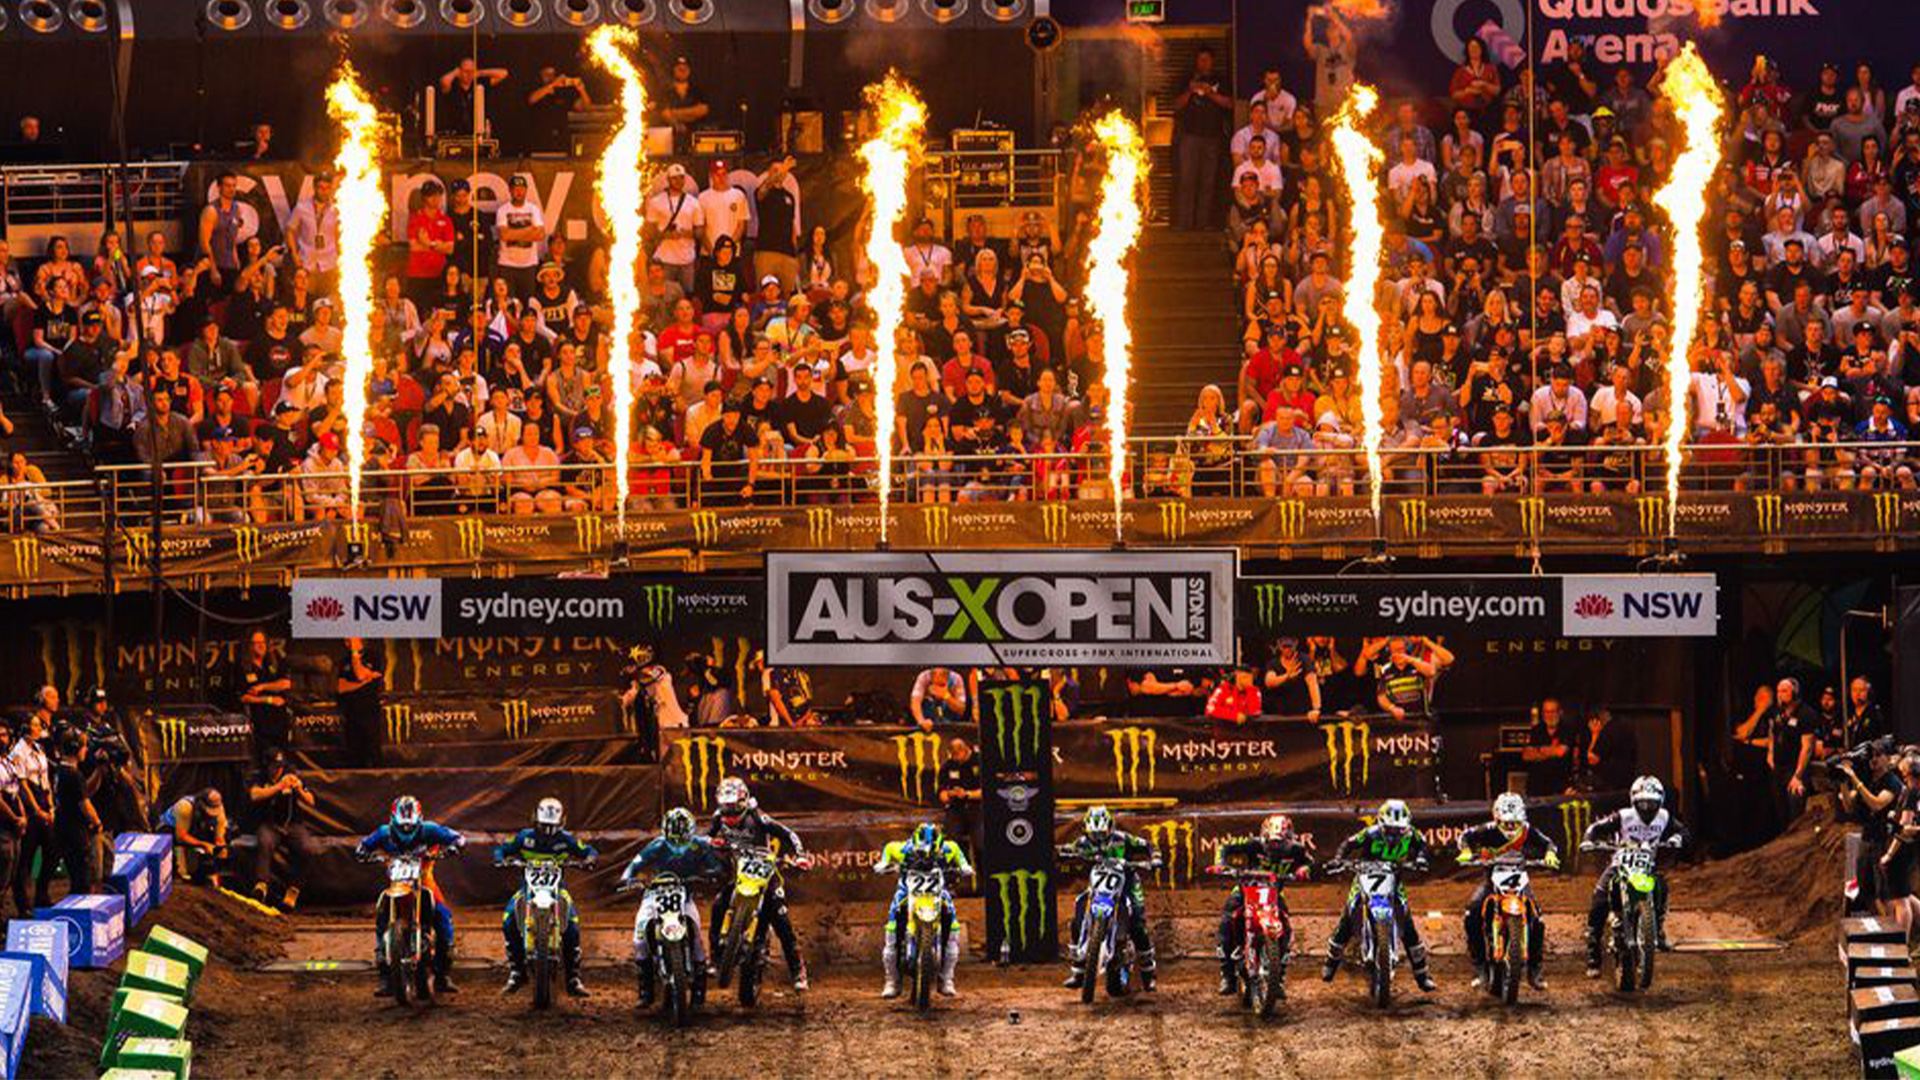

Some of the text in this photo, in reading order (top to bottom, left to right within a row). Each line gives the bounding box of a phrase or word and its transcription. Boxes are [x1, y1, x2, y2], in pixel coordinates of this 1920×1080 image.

[1188, 508, 1253, 521] MONSTER
[1307, 507, 1372, 519] MONSTER
[1429, 506, 1493, 519] MONSTER
[1548, 505, 1612, 517] MONSTER
[1677, 503, 1731, 515] ONSTER
[1784, 501, 1848, 513] MONSTER
[720, 516, 783, 529] MONSTER
[952, 513, 1016, 525] MONSTER
[371, 529, 434, 541] MTER
[486, 525, 550, 538] MONSTER
[161, 538, 212, 551] ONSTER
[677, 594, 748, 606] MONSTER
[1287, 593, 1358, 605] MONSTER
[1379, 590, 1545, 623] sydney.com
[1623, 592, 1702, 618] NSW
[353, 595, 431, 621] NSW
[460, 592, 624, 624] sydney.com
[1189, 577, 1205, 640] SYDNEY
[1003, 649, 1078, 657] SUPERCROSS
[1120, 649, 1212, 657] INTERNATIONAL
[1486, 639, 1614, 653] ENERGY
[117, 636, 286, 672] MONSTR
[464, 662, 591, 678] ENERGY
[413, 710, 478, 723] MONSTER
[531, 705, 595, 719] MONSTER
[1162, 739, 1277, 761] MONSTER
[1376, 733, 1442, 753] MONS
[731, 749, 848, 769] MONSTER
[804, 849, 882, 869] ONSTER
[530, 871, 559, 887] 237
[912, 875, 940, 895] 22
[1093, 870, 1121, 890] 70
[1367, 873, 1387, 893] 7
[1500, 873, 1522, 888] 4
[655, 893, 682, 913] 38
[1257, 887, 1271, 904] 1
